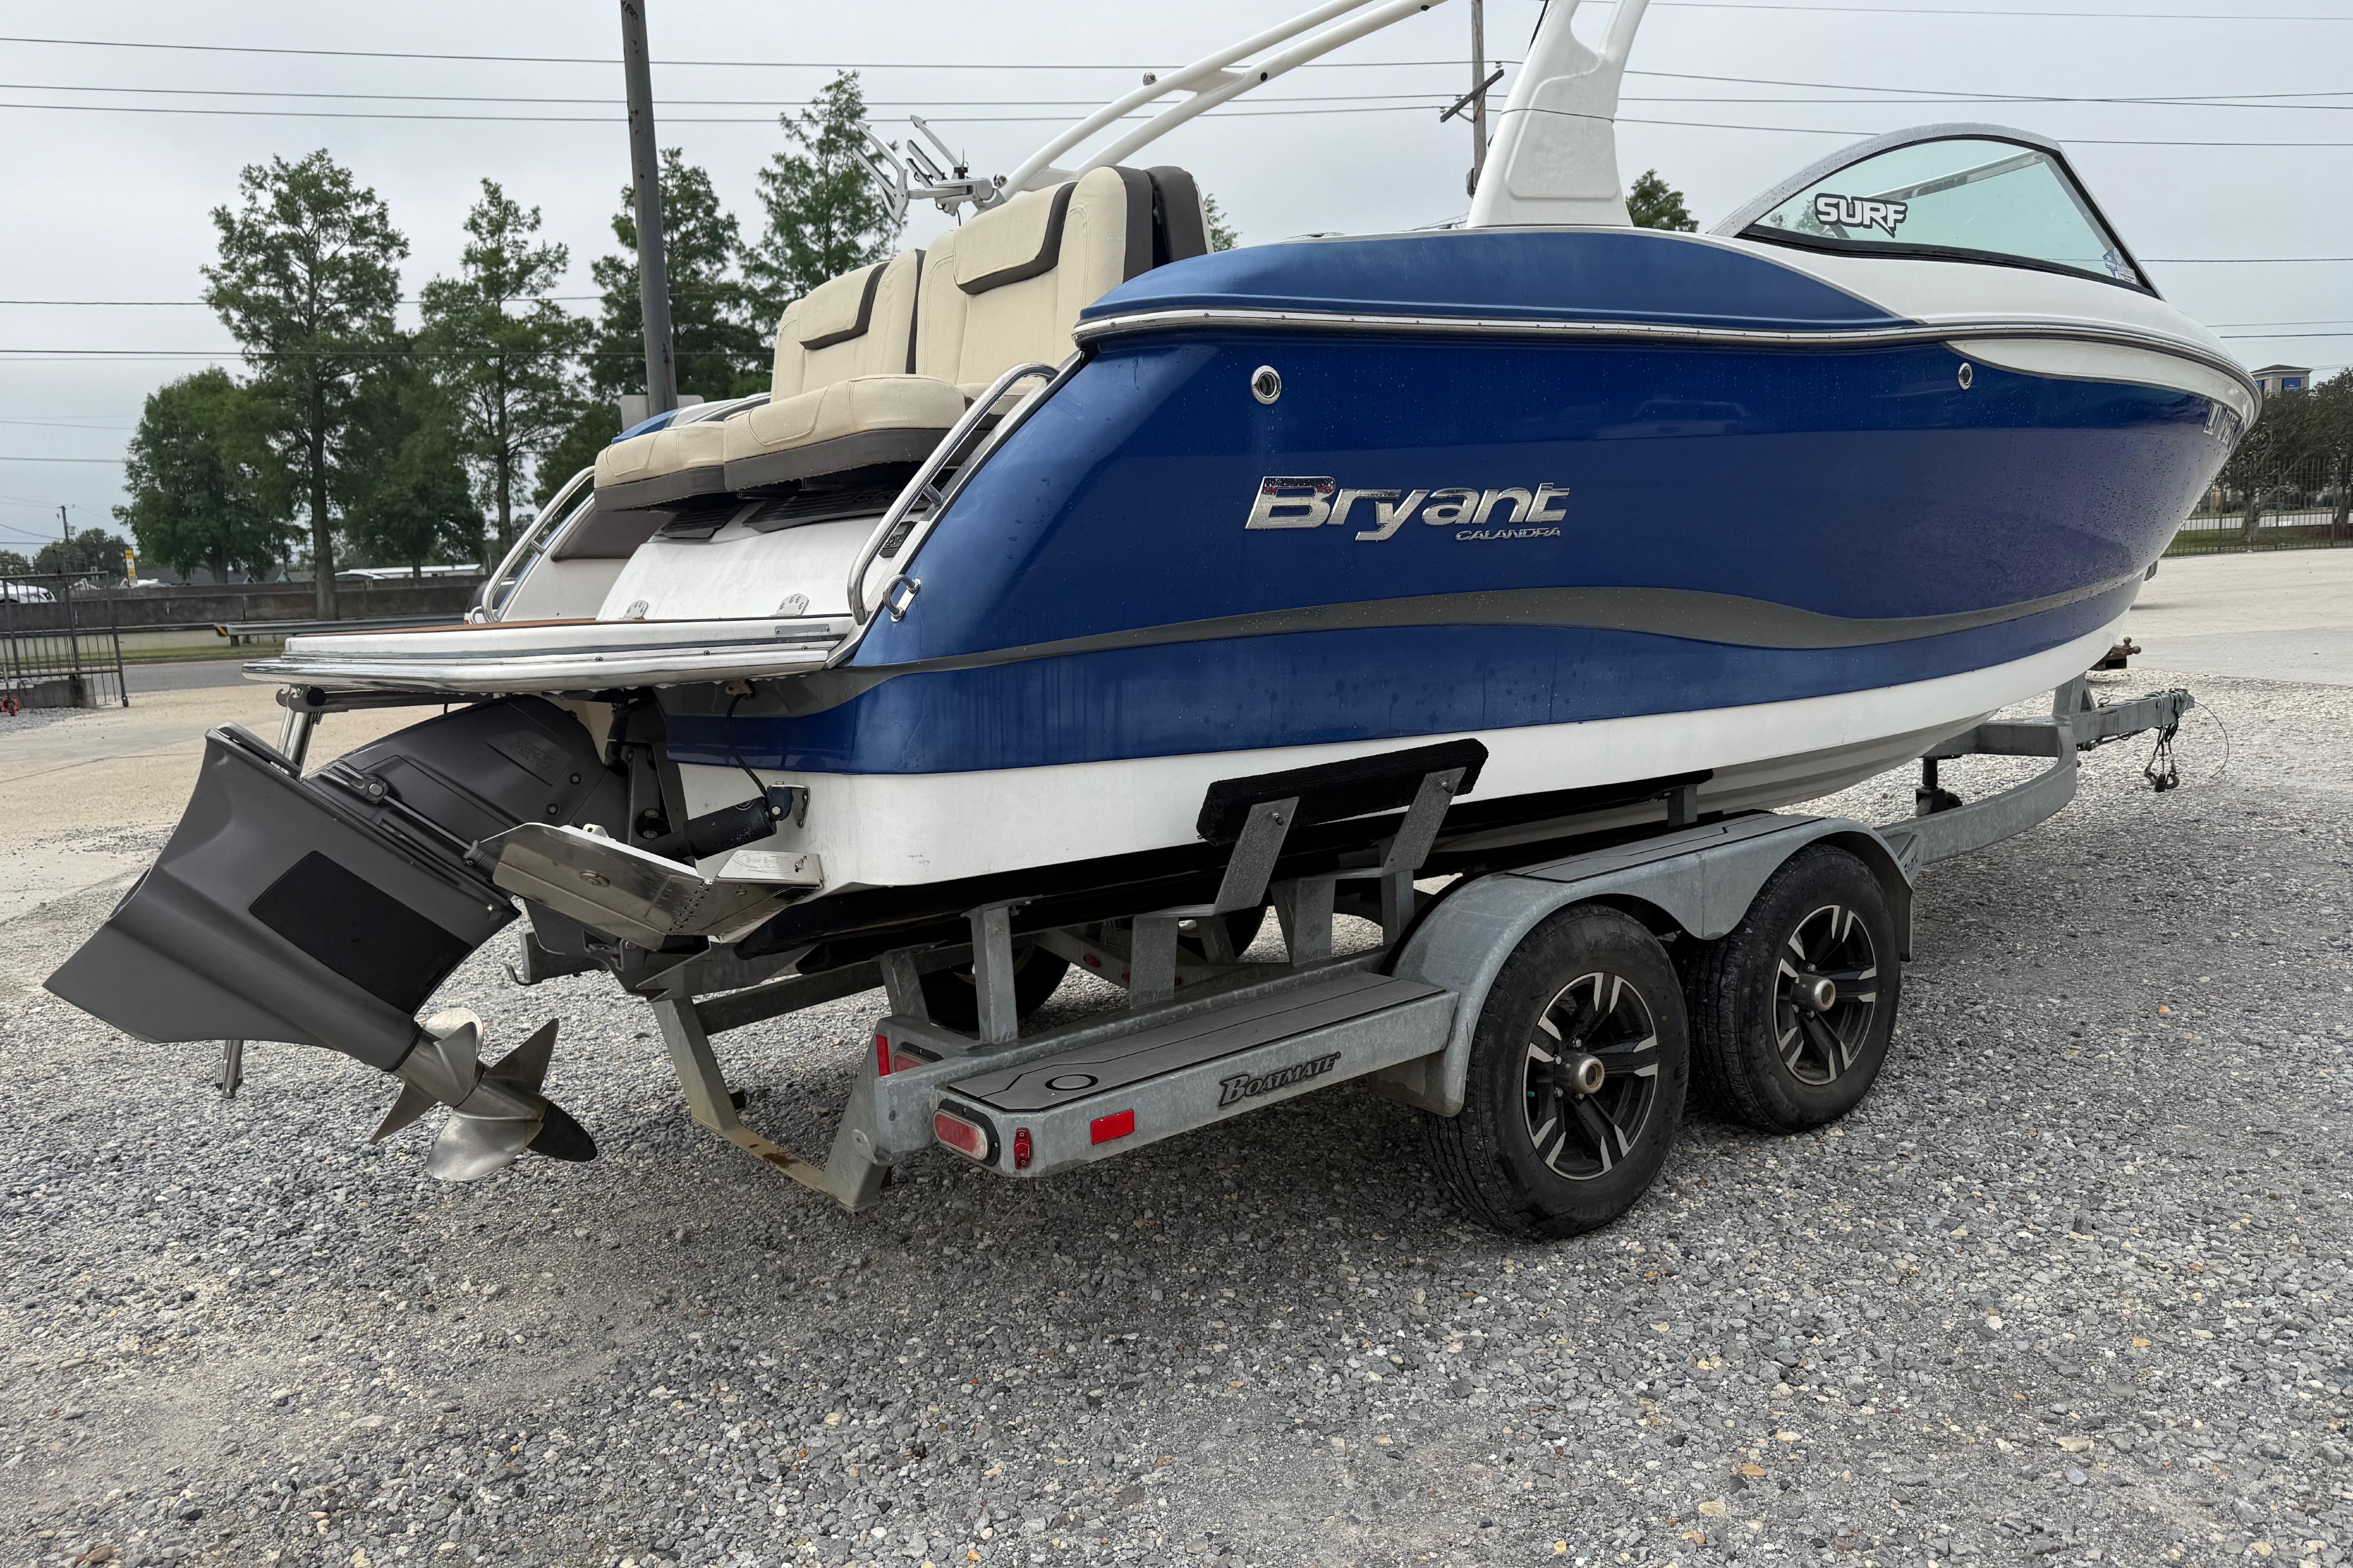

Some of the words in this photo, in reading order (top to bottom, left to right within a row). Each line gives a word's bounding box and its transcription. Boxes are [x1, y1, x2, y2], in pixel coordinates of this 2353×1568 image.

[1816, 195, 1907, 235] SURF
[1245, 476, 1569, 541] Bryant
[1455, 527, 1561, 541] CALANDRA
[1220, 1055, 1336, 1105] BOATMATE
